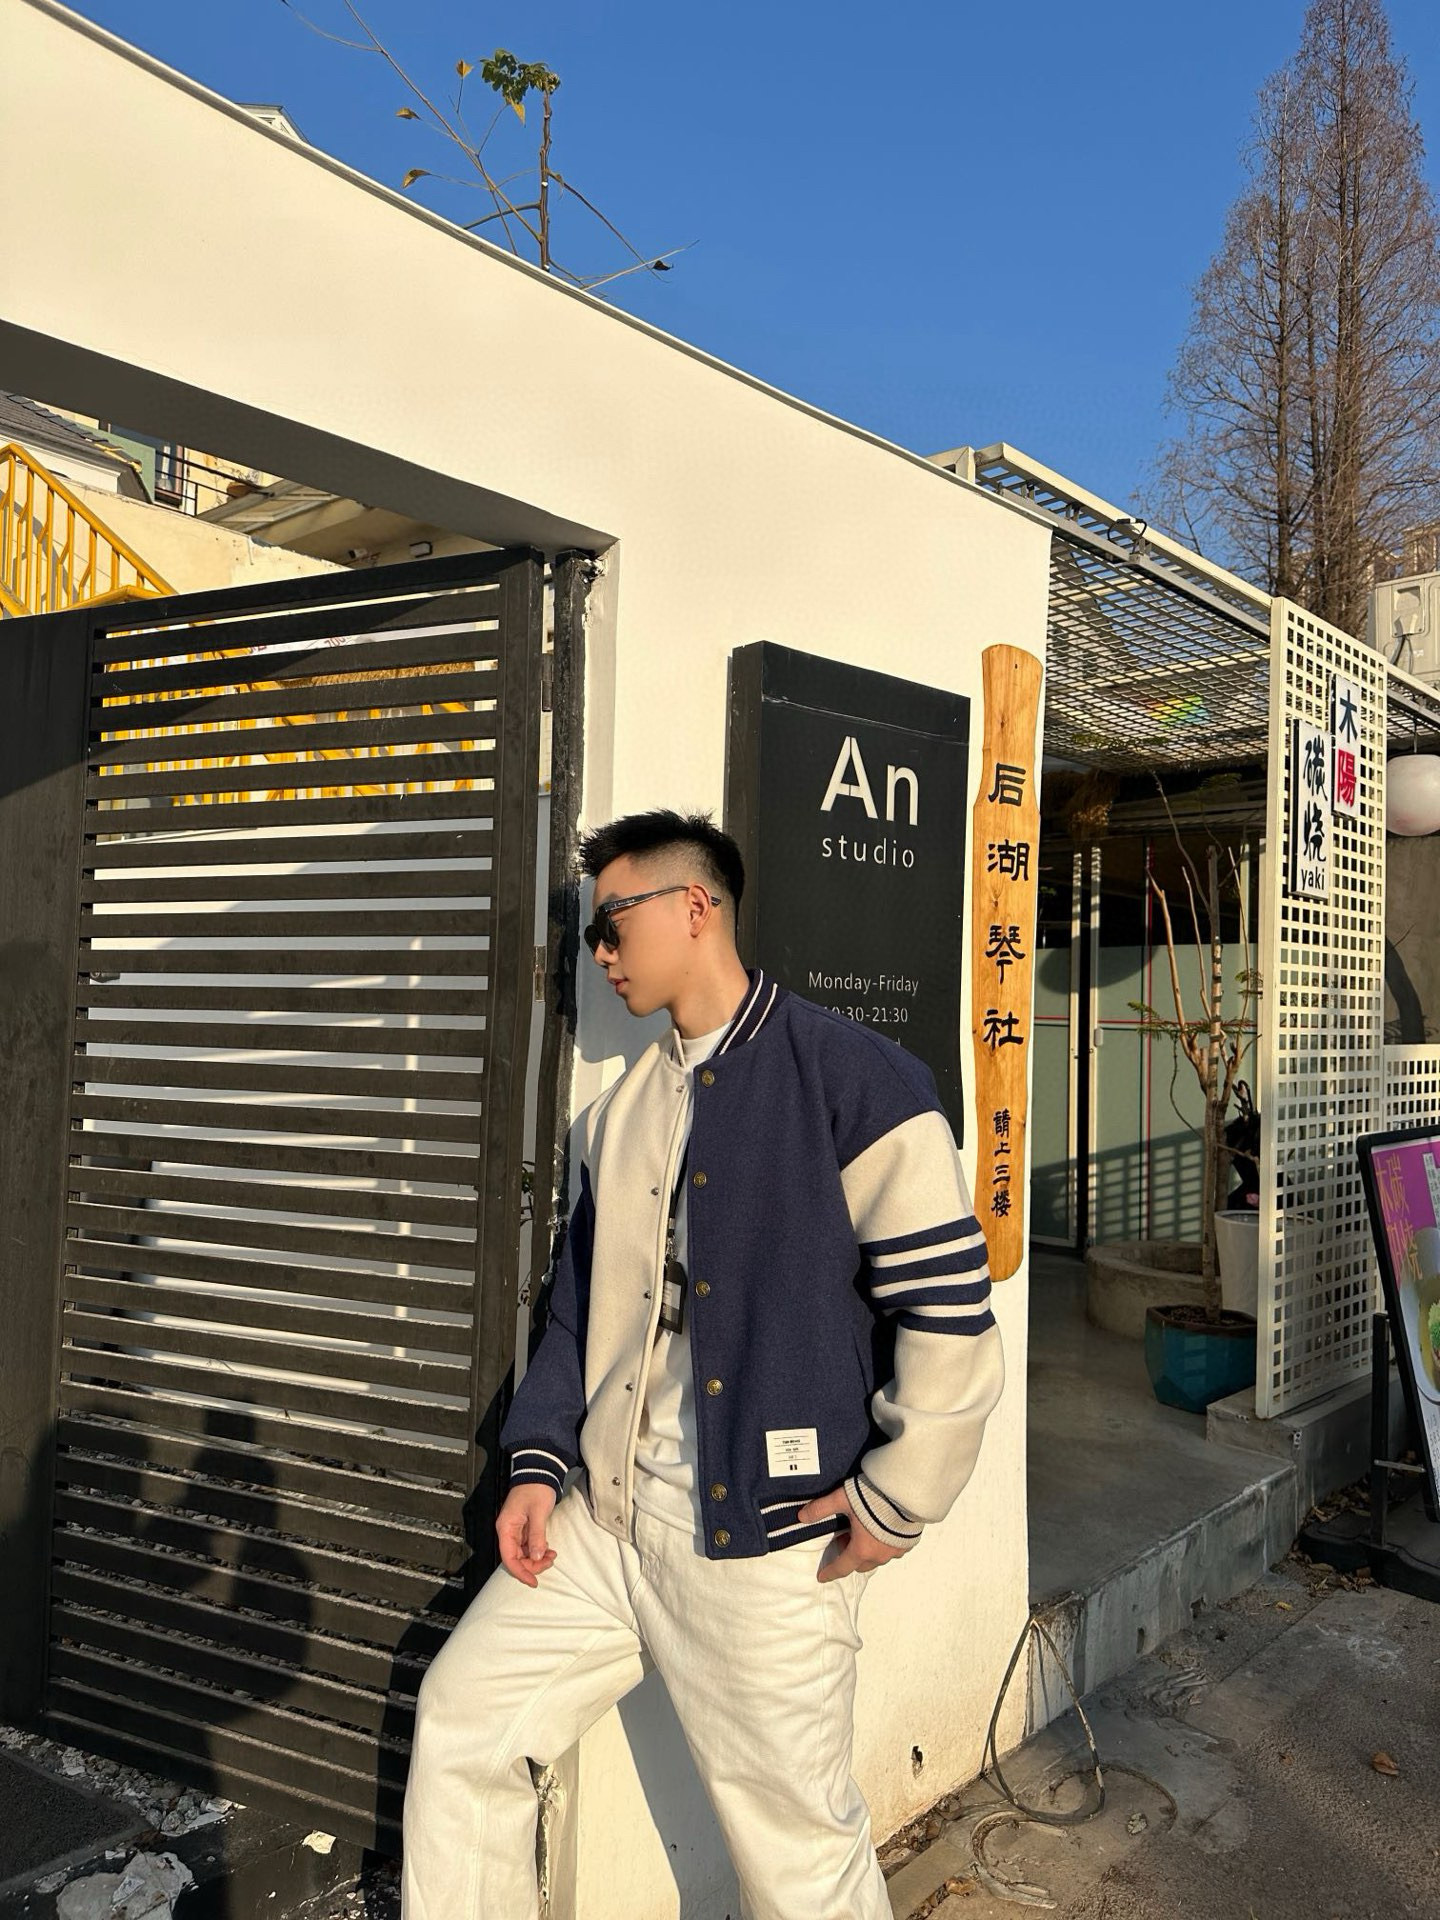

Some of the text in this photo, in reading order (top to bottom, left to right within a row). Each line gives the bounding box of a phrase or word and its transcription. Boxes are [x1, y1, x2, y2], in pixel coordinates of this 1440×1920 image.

[1338, 689, 1358, 808] 木陽
[820, 735, 919, 826] An
[822, 834, 915, 868] studio
[1301, 866, 1325, 892] yaki
[983, 762, 1030, 1050] 后湖琴社
[808, 971, 919, 997] Monday-Friday
